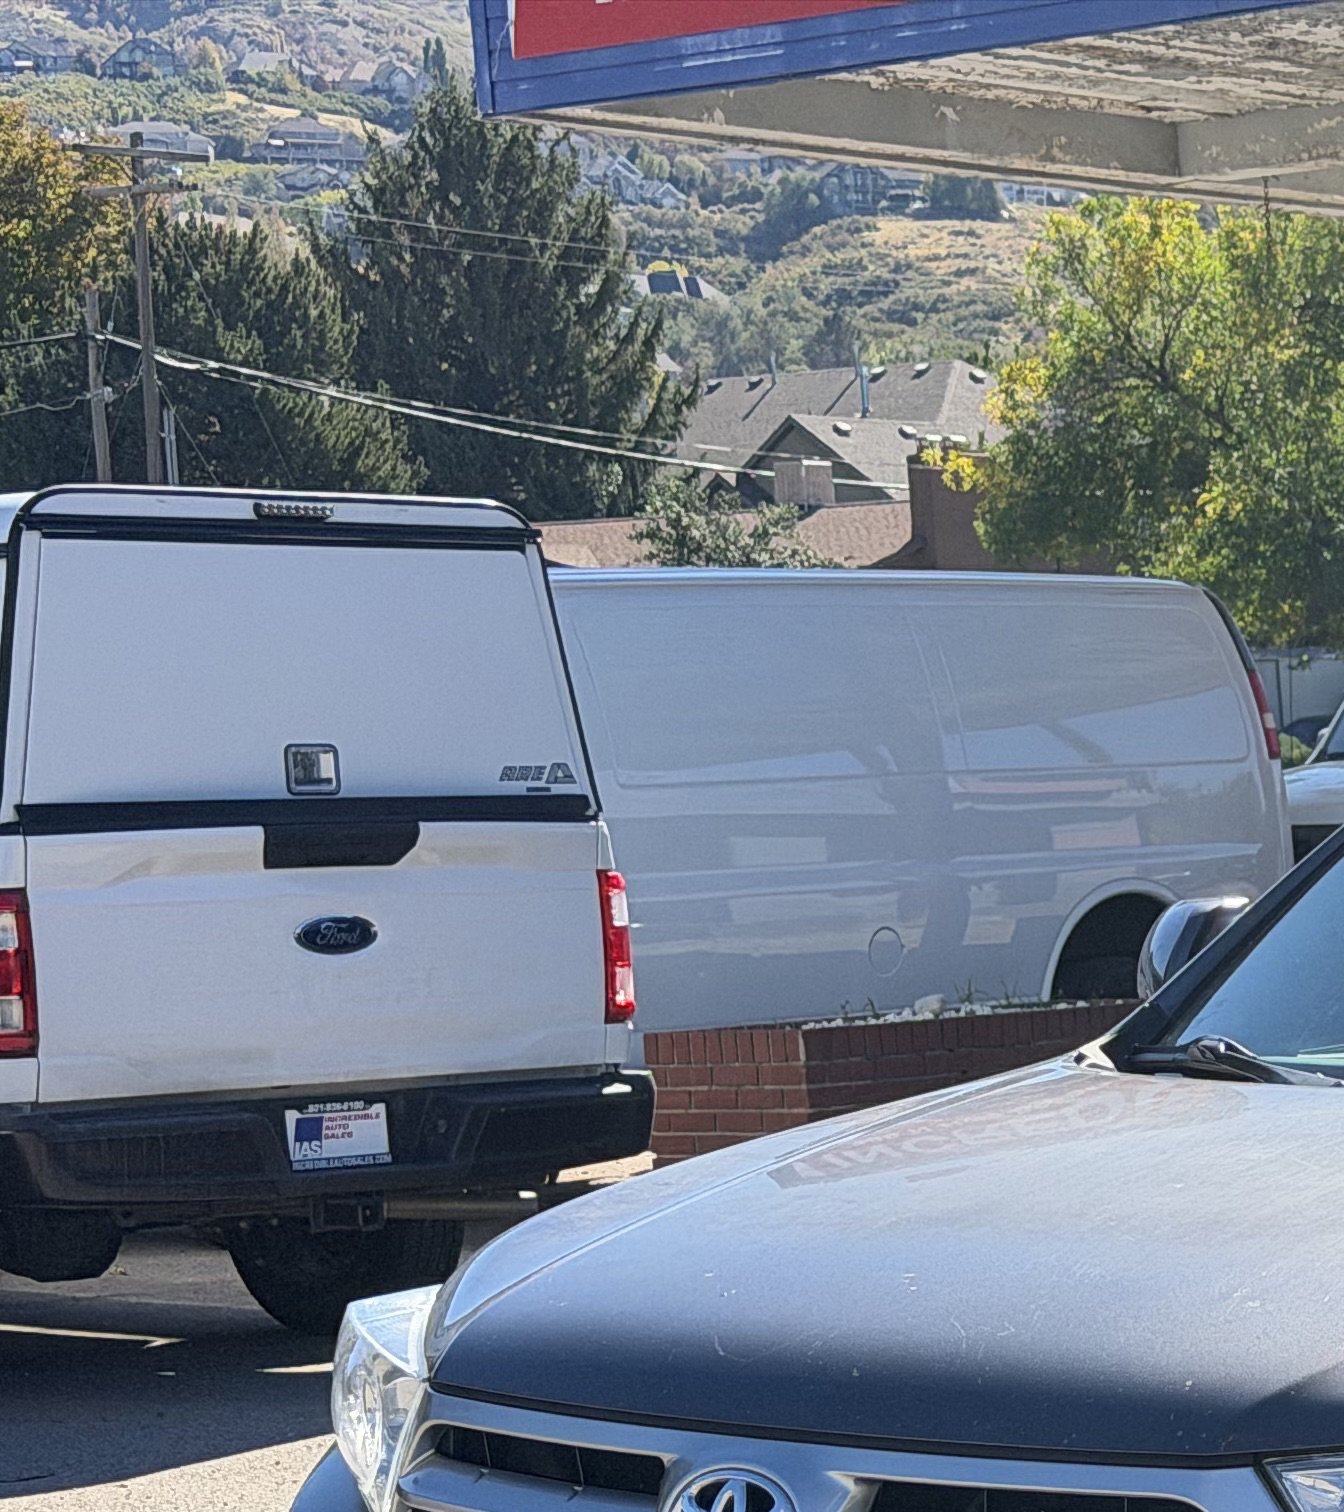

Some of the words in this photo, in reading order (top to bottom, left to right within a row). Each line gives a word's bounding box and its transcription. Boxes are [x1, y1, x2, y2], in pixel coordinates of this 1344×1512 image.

[317, 921, 360, 945] Ford
[325, 1112, 381, 1122] INCREDIBLE
[325, 1123, 349, 1131] AUTO
[324, 1131, 353, 1140] SALES
[294, 1141, 322, 1159] IAS
